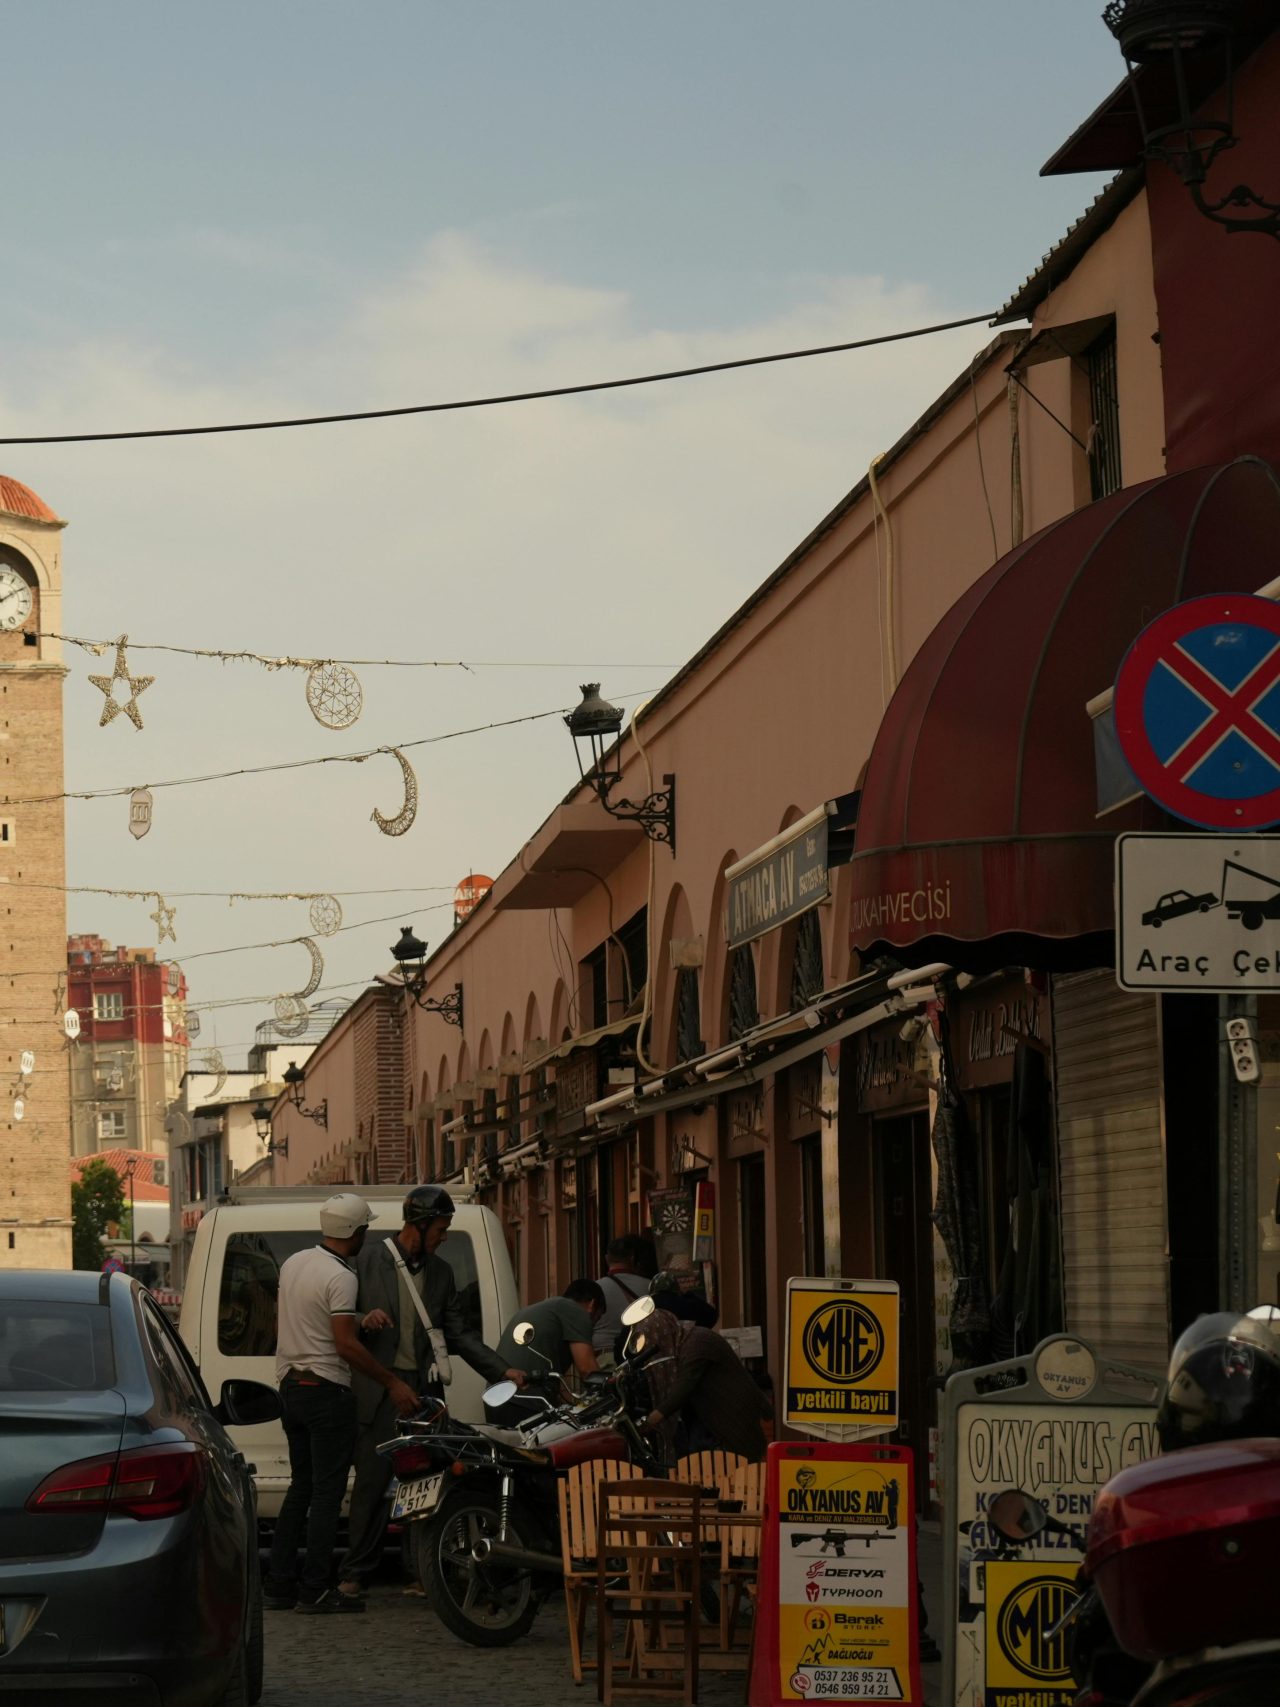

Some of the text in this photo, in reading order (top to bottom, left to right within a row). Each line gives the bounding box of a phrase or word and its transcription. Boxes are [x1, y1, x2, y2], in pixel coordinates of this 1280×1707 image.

[734, 863, 778, 937] ATMACA
[781, 849, 794, 912] AV
[1137, 949, 1209, 976] Araç
[811, 1308, 875, 1375] MKE
[1043, 1372, 1087, 1386] OKYANUS
[1056, 1384, 1071, 1393] AV
[796, 1390, 889, 1412] yetkili bayii
[969, 1418, 1112, 1492] OKYANUS
[400, 1476, 440, 1499] 01 AKT
[407, 1494, 427, 1511] 517
[787, 1488, 884, 1514] OKYANUS AV
[825, 1568, 884, 1578] DERYA
[834, 1613, 884, 1625] Barak
[828, 1647, 874, 1660] DAĞLIOĞLU
[814, 1670, 888, 1683] 0537 236 95 21
[815, 1683, 888, 1695] 0546 959 14 21
